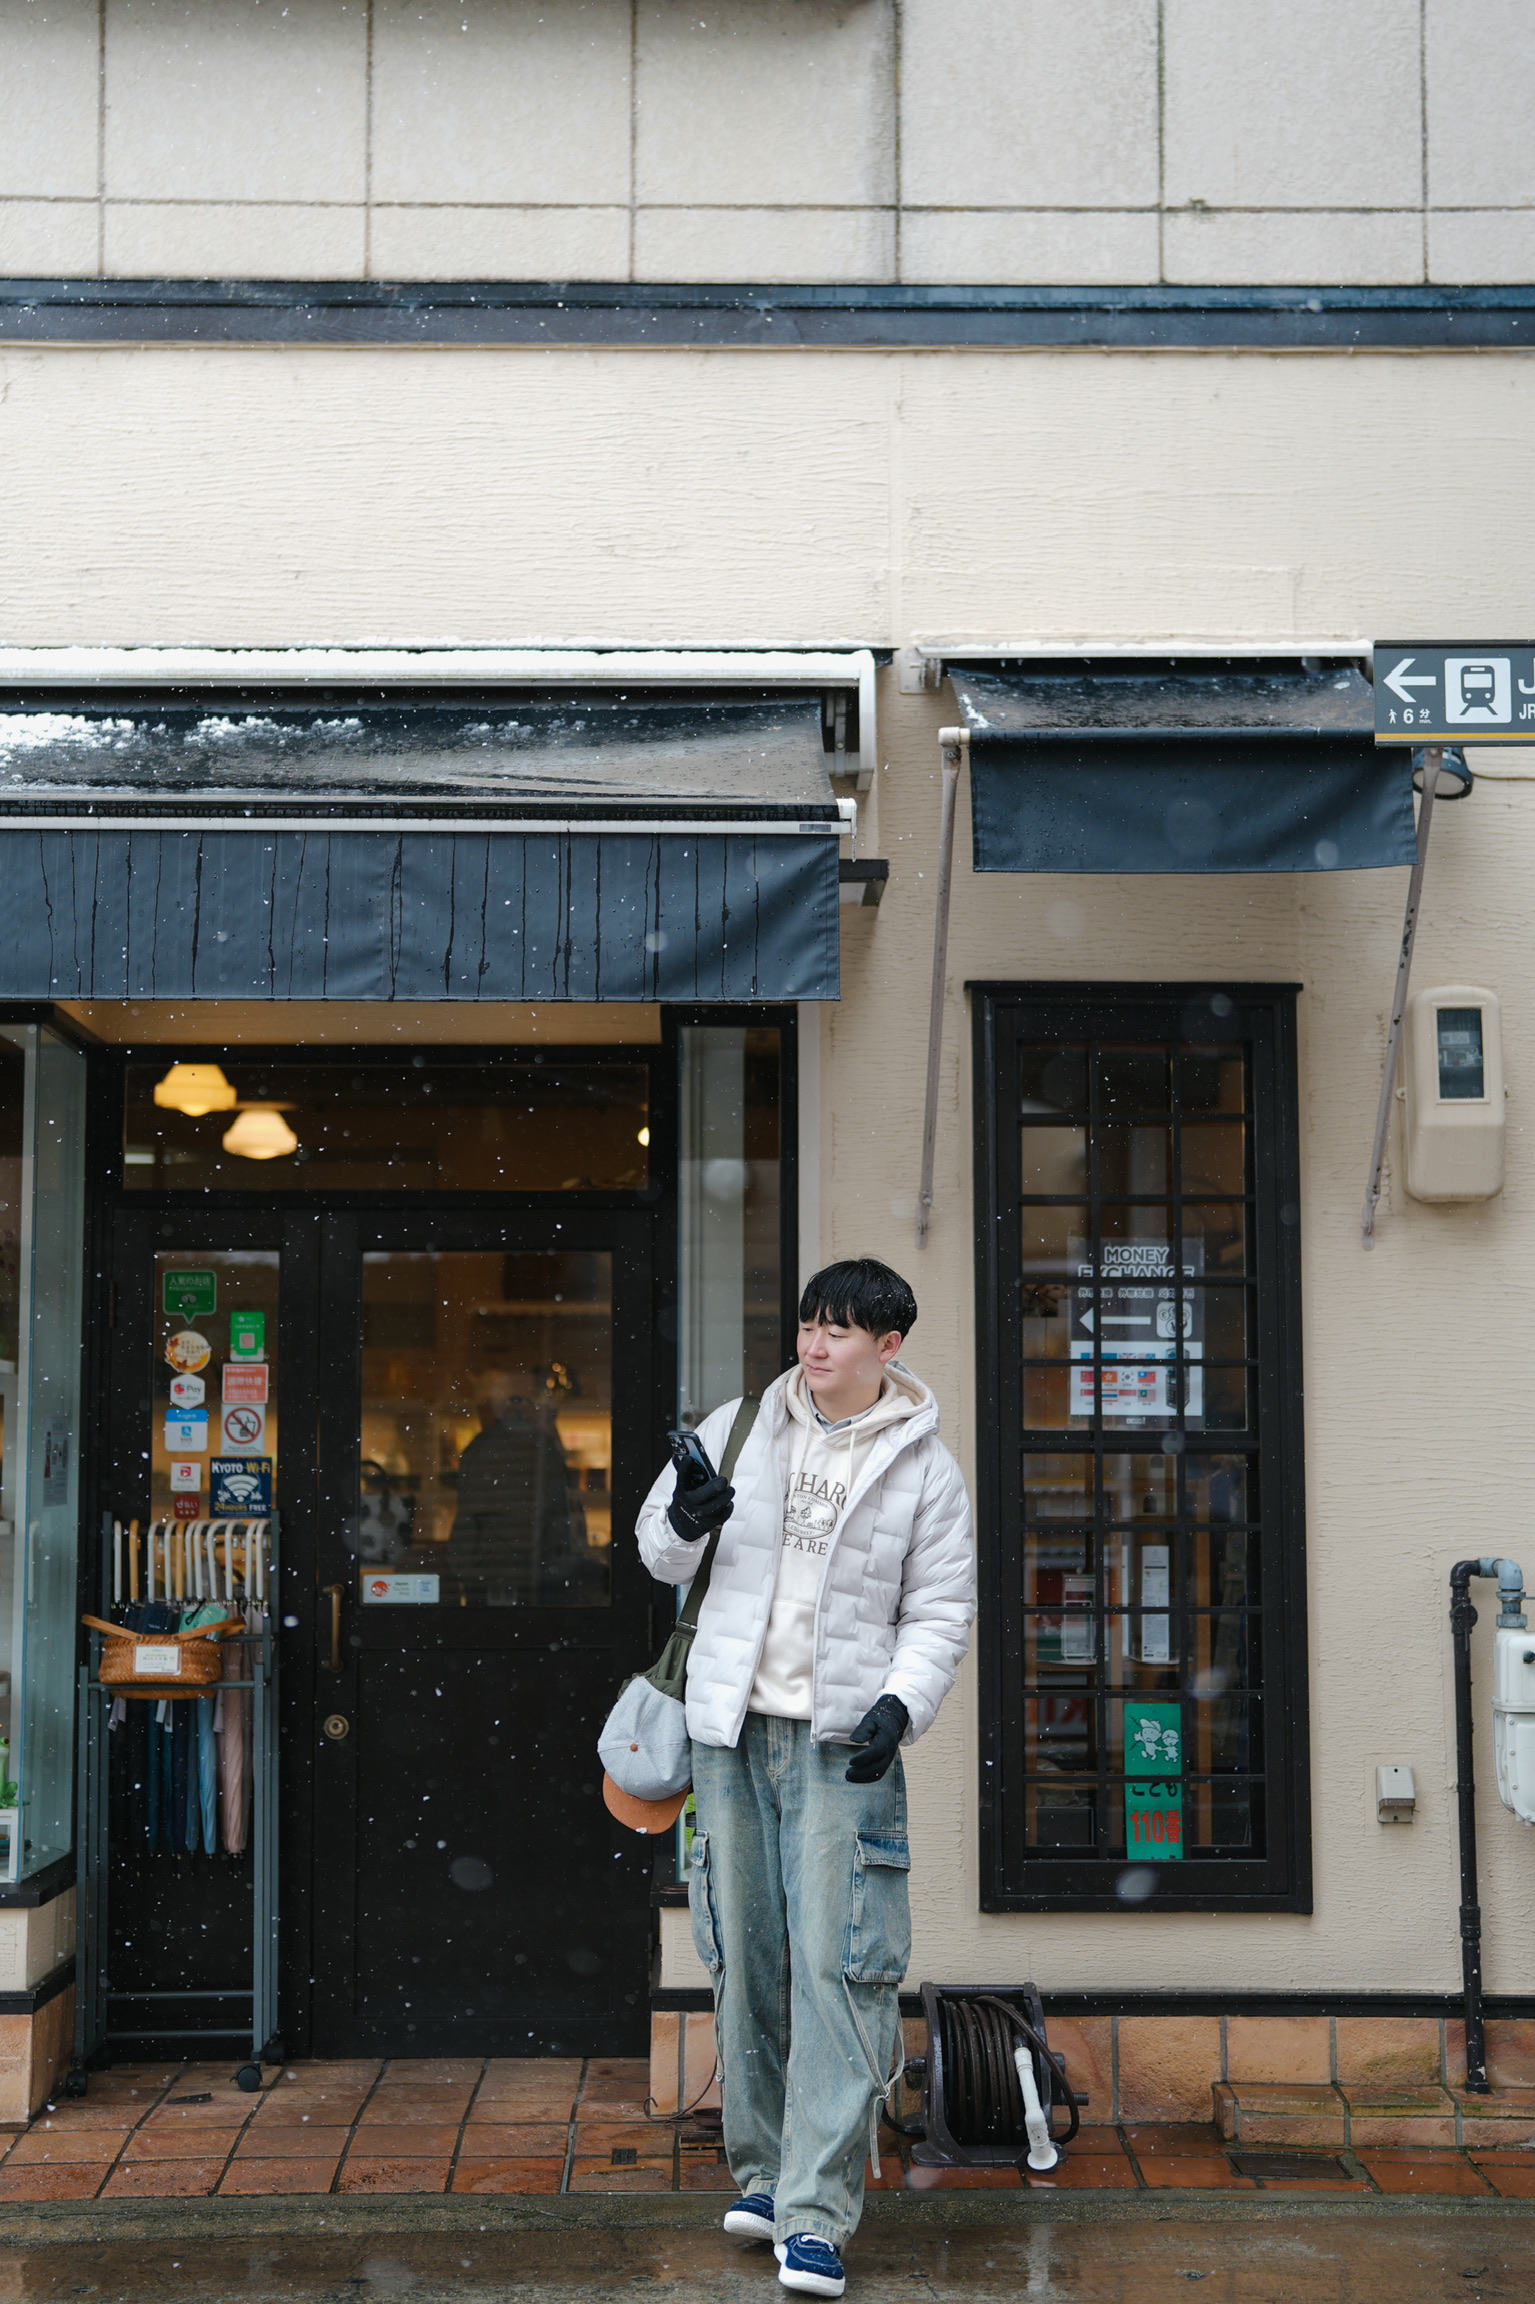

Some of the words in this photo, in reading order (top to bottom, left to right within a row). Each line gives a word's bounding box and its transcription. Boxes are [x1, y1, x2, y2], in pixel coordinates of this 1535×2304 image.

[1403, 708, 1414, 725] 6
[1419, 708, 1431, 719] 分
[1105, 1247, 1169, 1264] MONEY
[211, 1461, 243, 1474] KYOTO
[246, 1461, 271, 1473] Wi-Fi
[1130, 1810, 1182, 1843] 110番
